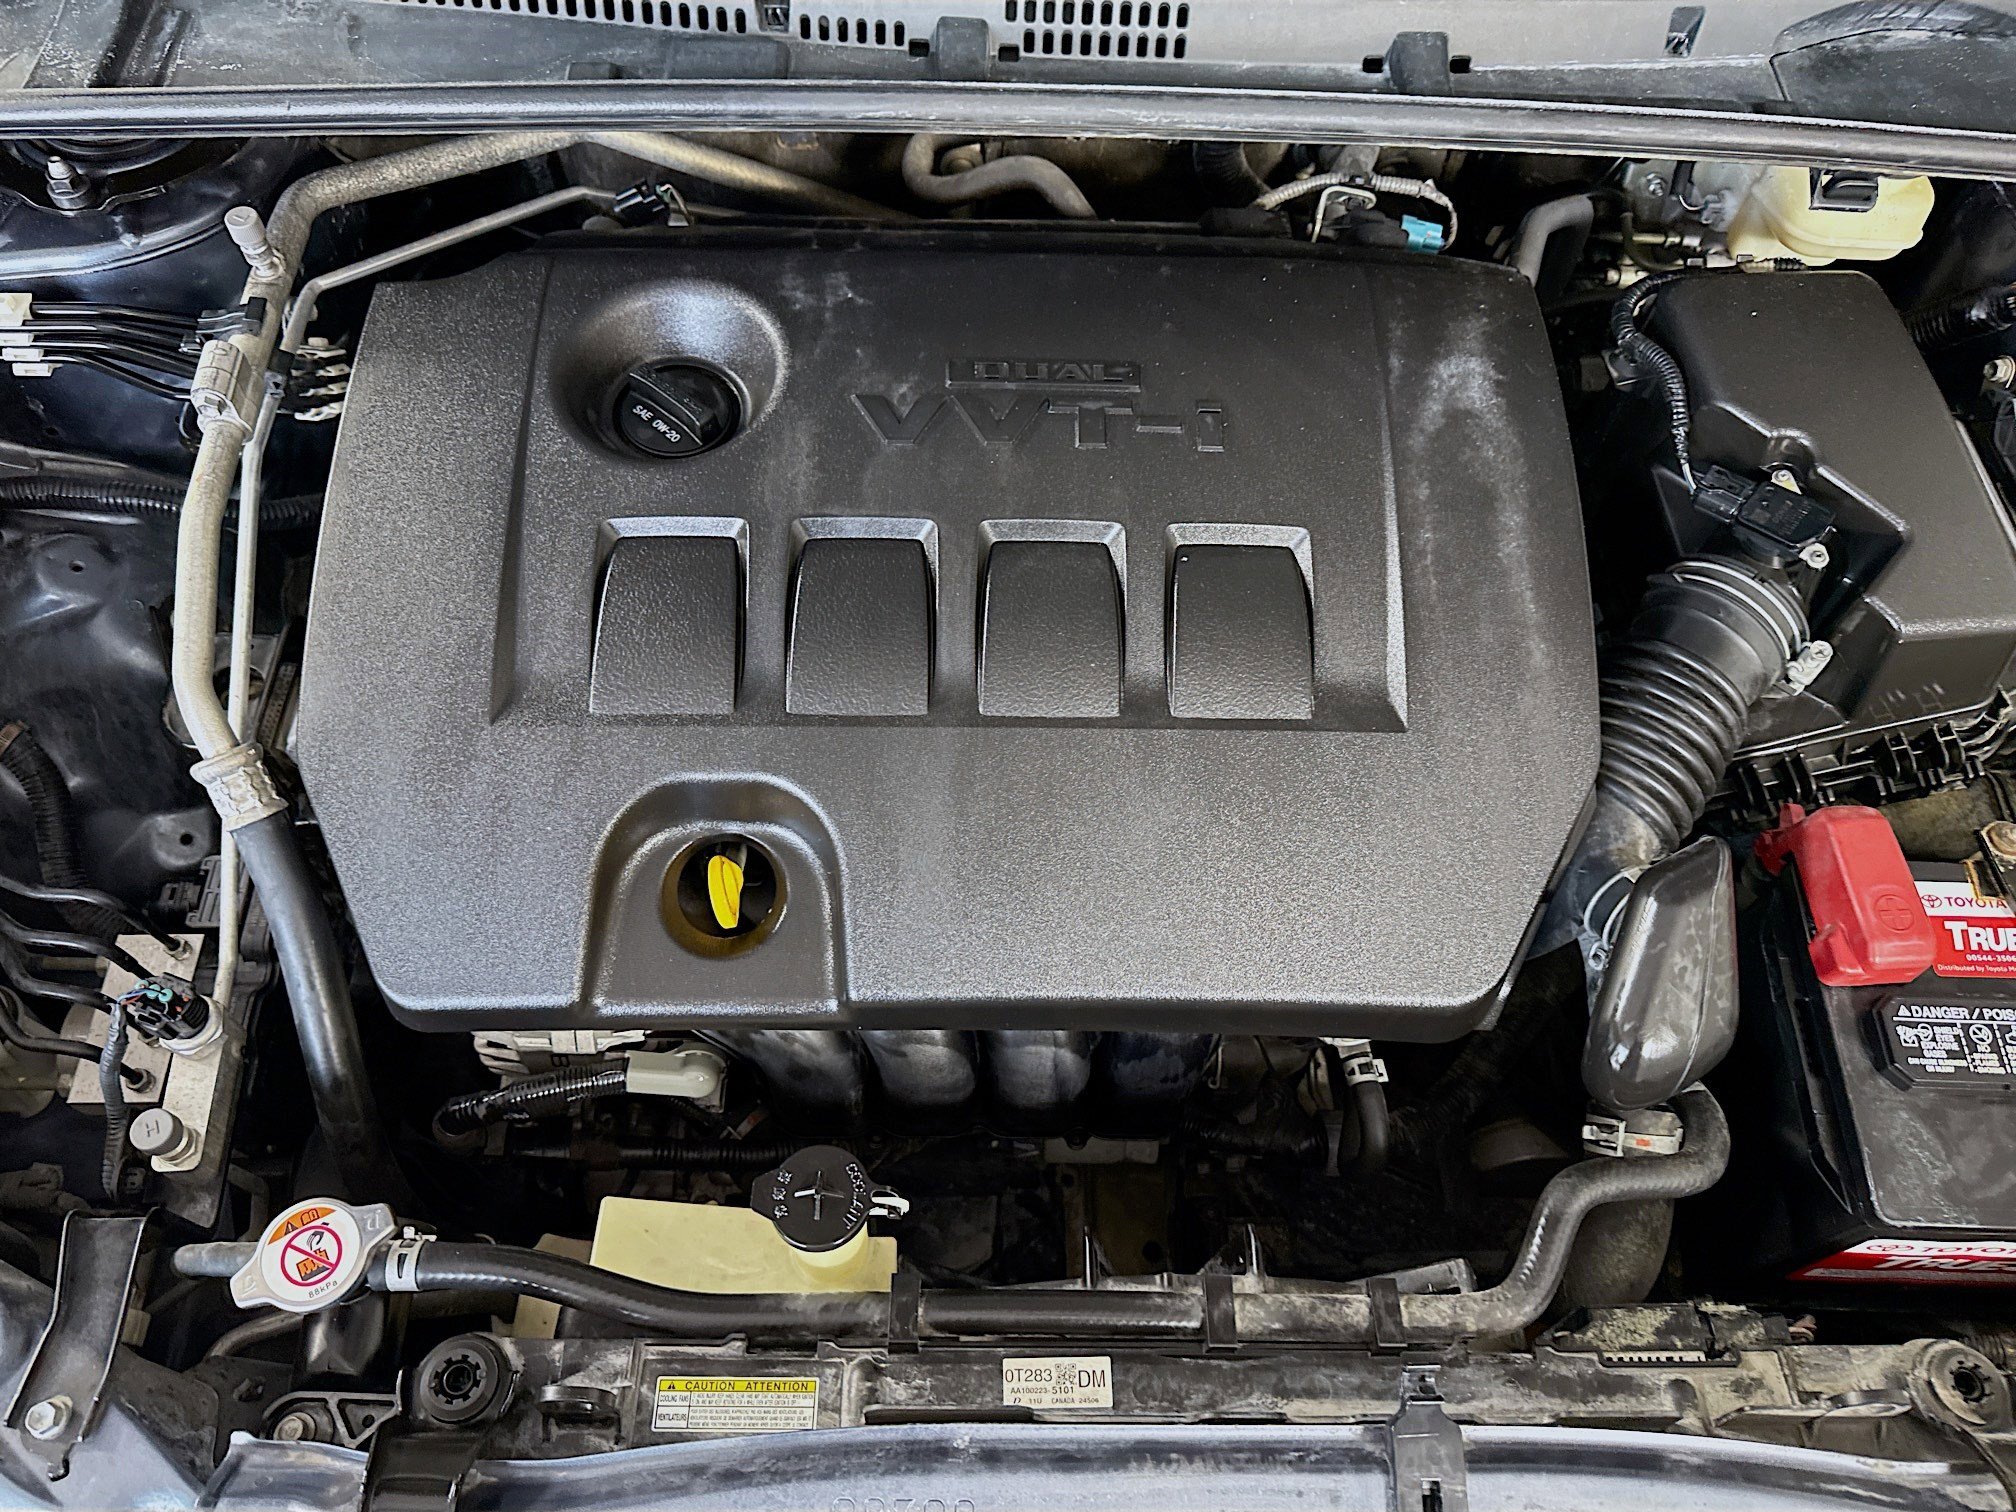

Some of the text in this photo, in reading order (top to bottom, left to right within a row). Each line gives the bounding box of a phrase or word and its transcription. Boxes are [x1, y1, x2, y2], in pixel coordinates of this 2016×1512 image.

[973, 361, 1125, 382] DUAL
[632, 405, 680, 443] SAE 0W-20
[851, 394, 1224, 452] VVT-i
[1944, 896, 2007, 909] TOYOTA
[1976, 964, 1984, 972] by
[1985, 965, 2008, 973] Toyota
[1911, 1005, 2016, 1021] DANGER / POIS
[845, 1163, 866, 1230] COOLANT
[308, 1280, 338, 1299] 88kPa
[685, 1381, 808, 1391] CAUTION ATTENTION
[1078, 1370, 1106, 1388] DM
[658, 1413, 687, 1421] VENTILATEURS
